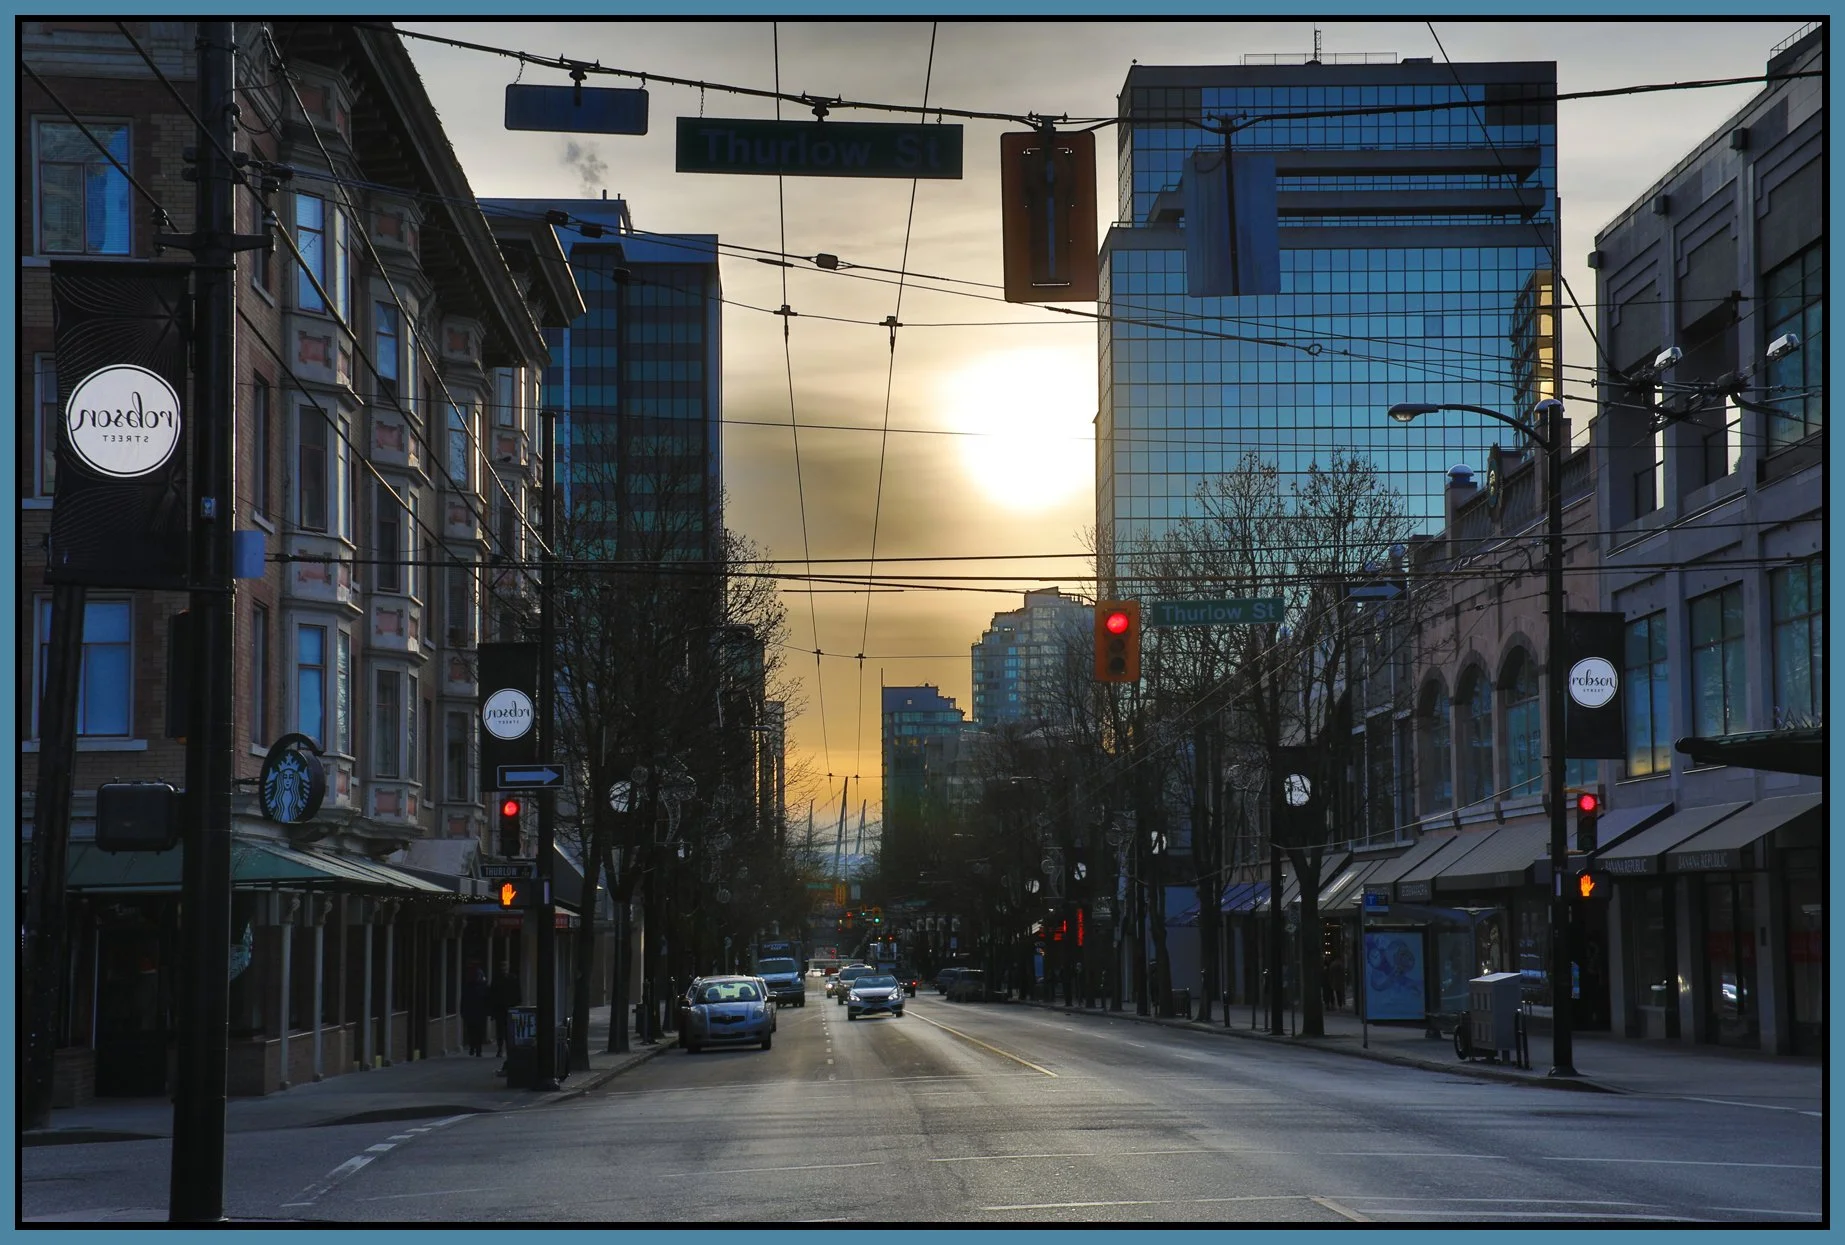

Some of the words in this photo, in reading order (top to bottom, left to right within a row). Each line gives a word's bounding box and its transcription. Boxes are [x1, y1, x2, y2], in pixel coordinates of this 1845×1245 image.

[698, 128, 873, 168] Thurlow
[894, 133, 942, 169] St
[1161, 604, 1242, 622] Thurlow
[1252, 602, 1275, 620] St
[1572, 668, 1616, 688] robson
[485, 866, 517, 877] THURLOW
